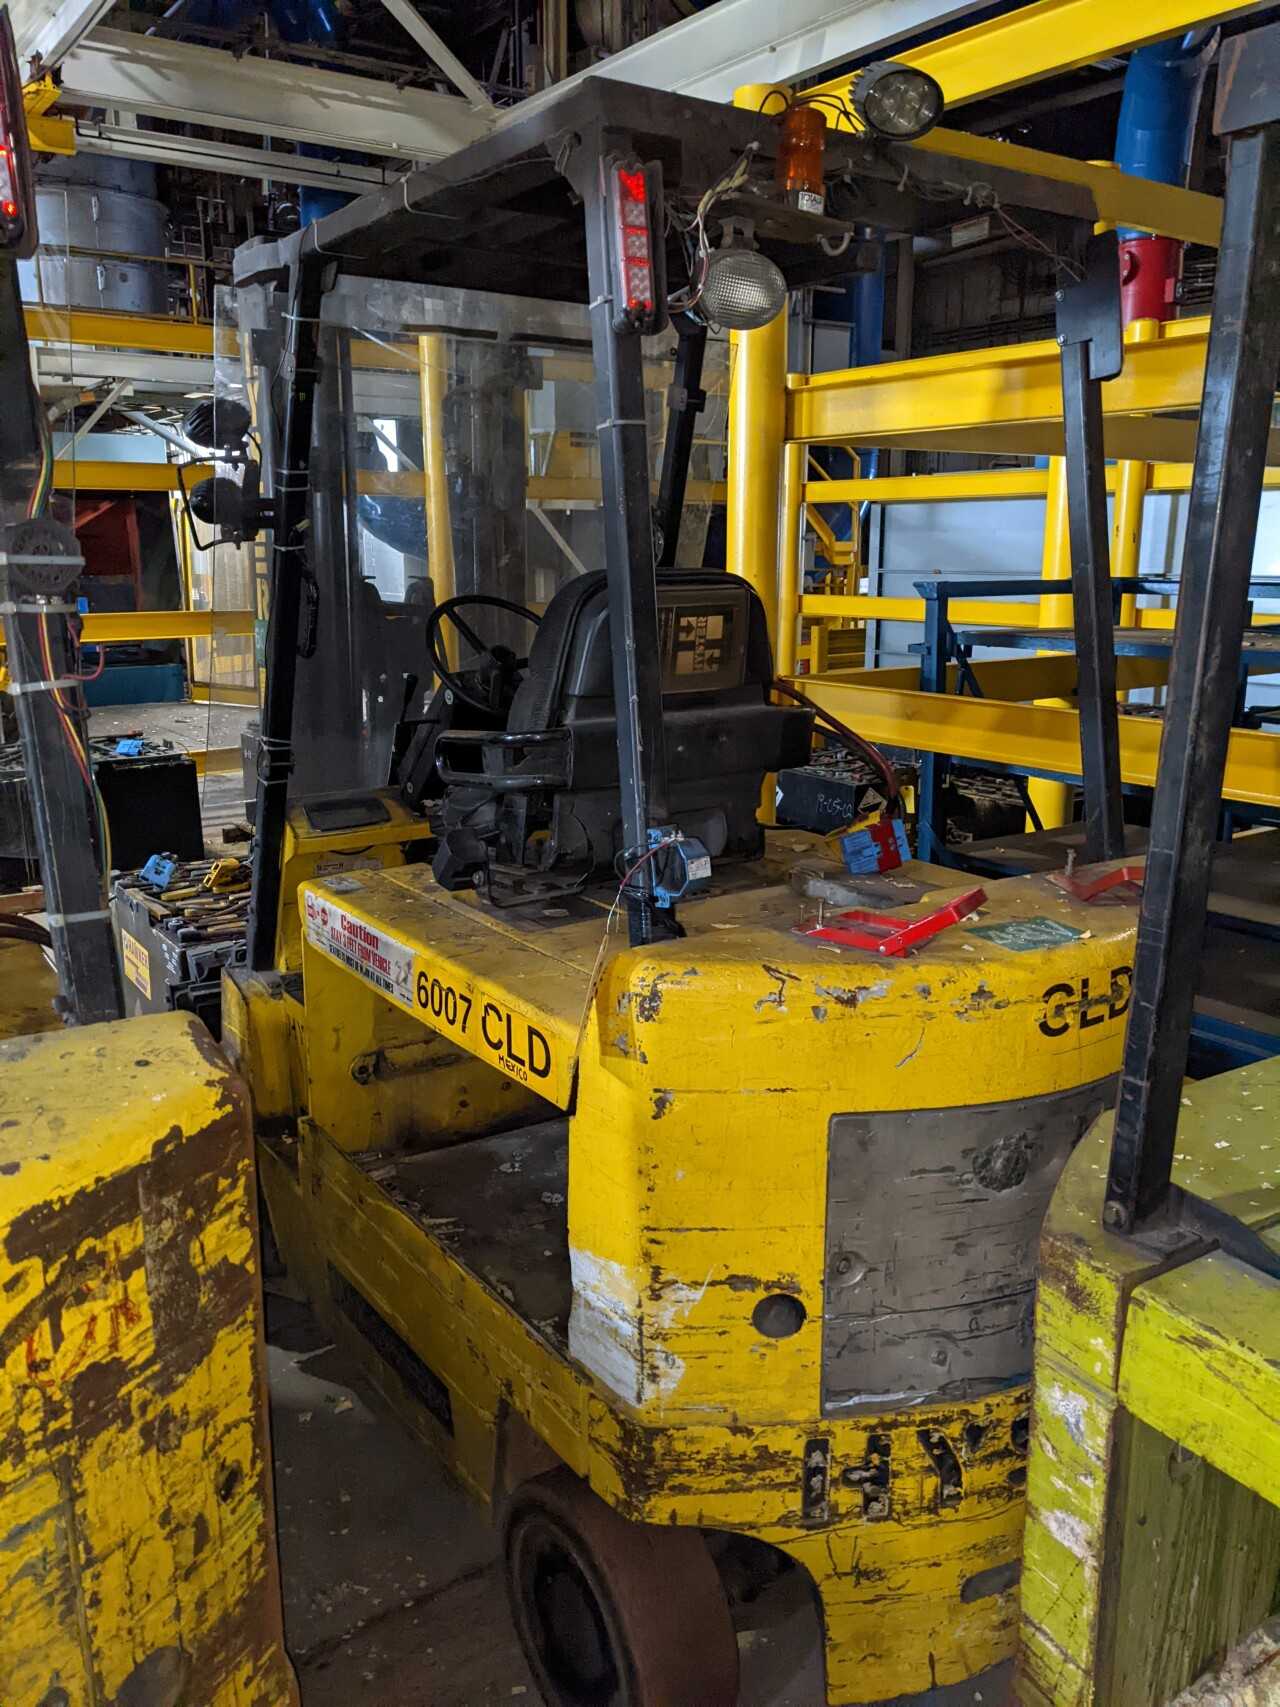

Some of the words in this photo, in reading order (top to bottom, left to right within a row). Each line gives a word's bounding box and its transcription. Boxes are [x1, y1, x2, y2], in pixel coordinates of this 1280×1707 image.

[341, 914, 379, 950] Caution
[416, 970, 473, 1034] 6007
[481, 1002, 551, 1079] CLD
[1038, 965, 1133, 1037] CLD
[498, 1054, 528, 1082] MEXICO
